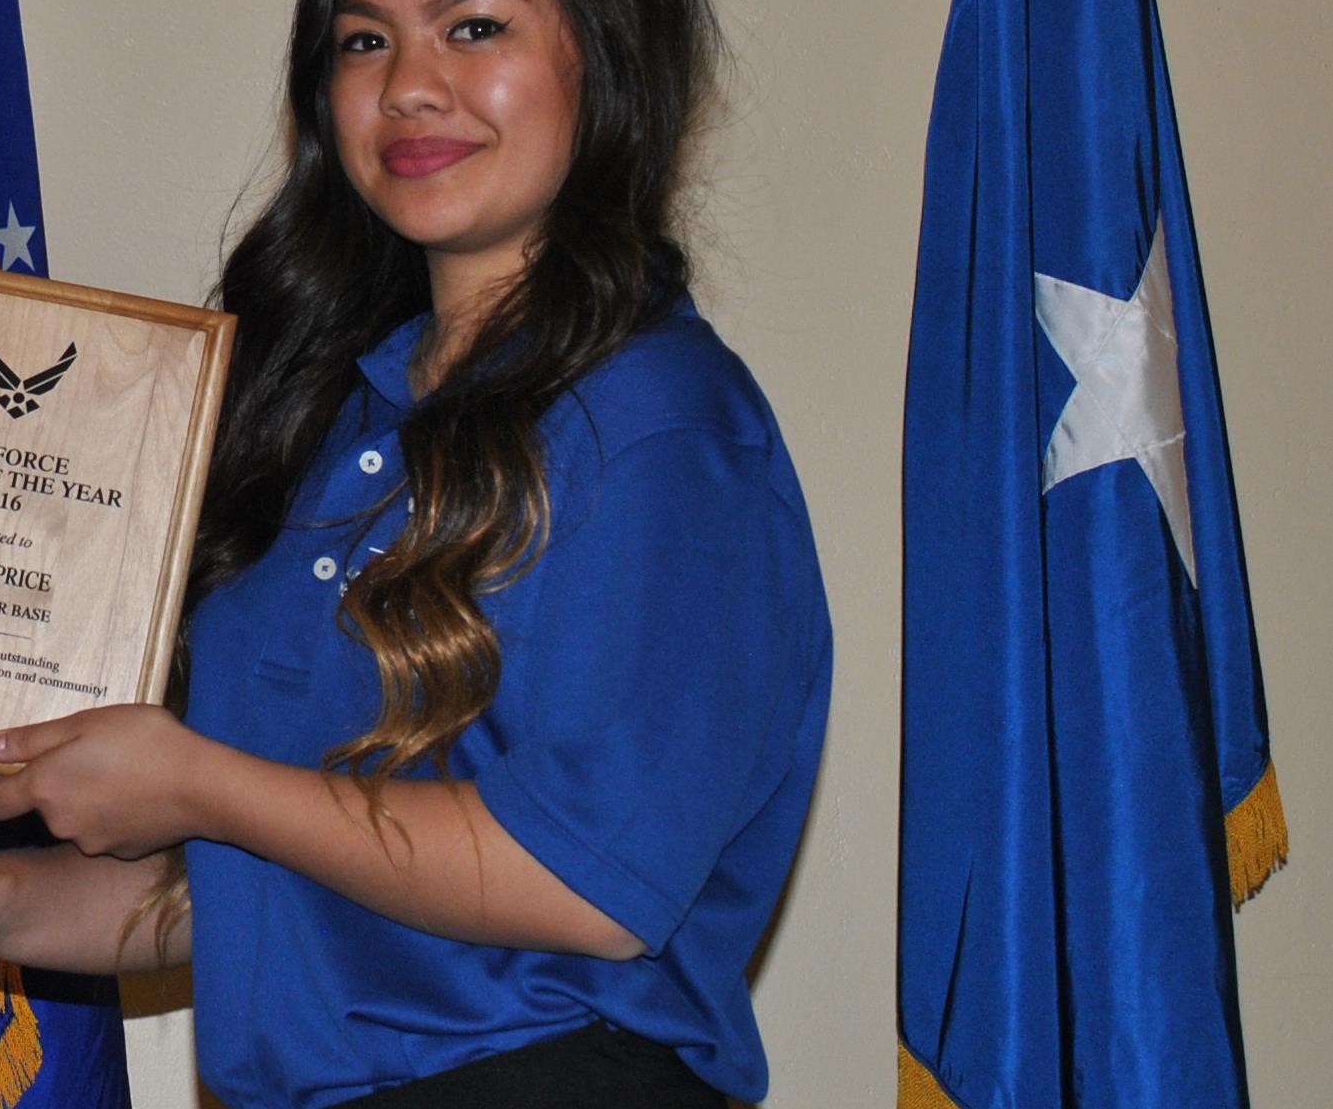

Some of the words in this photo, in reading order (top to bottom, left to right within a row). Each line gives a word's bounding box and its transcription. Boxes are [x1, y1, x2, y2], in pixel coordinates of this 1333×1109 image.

[9, 471, 54, 494] THE
[62, 480, 122, 507] YEAR
[20, 535, 33, 549] to
[11, 604, 51, 623] BASE
[14, 670, 36, 684] and
[38, 676, 108, 698] community!
